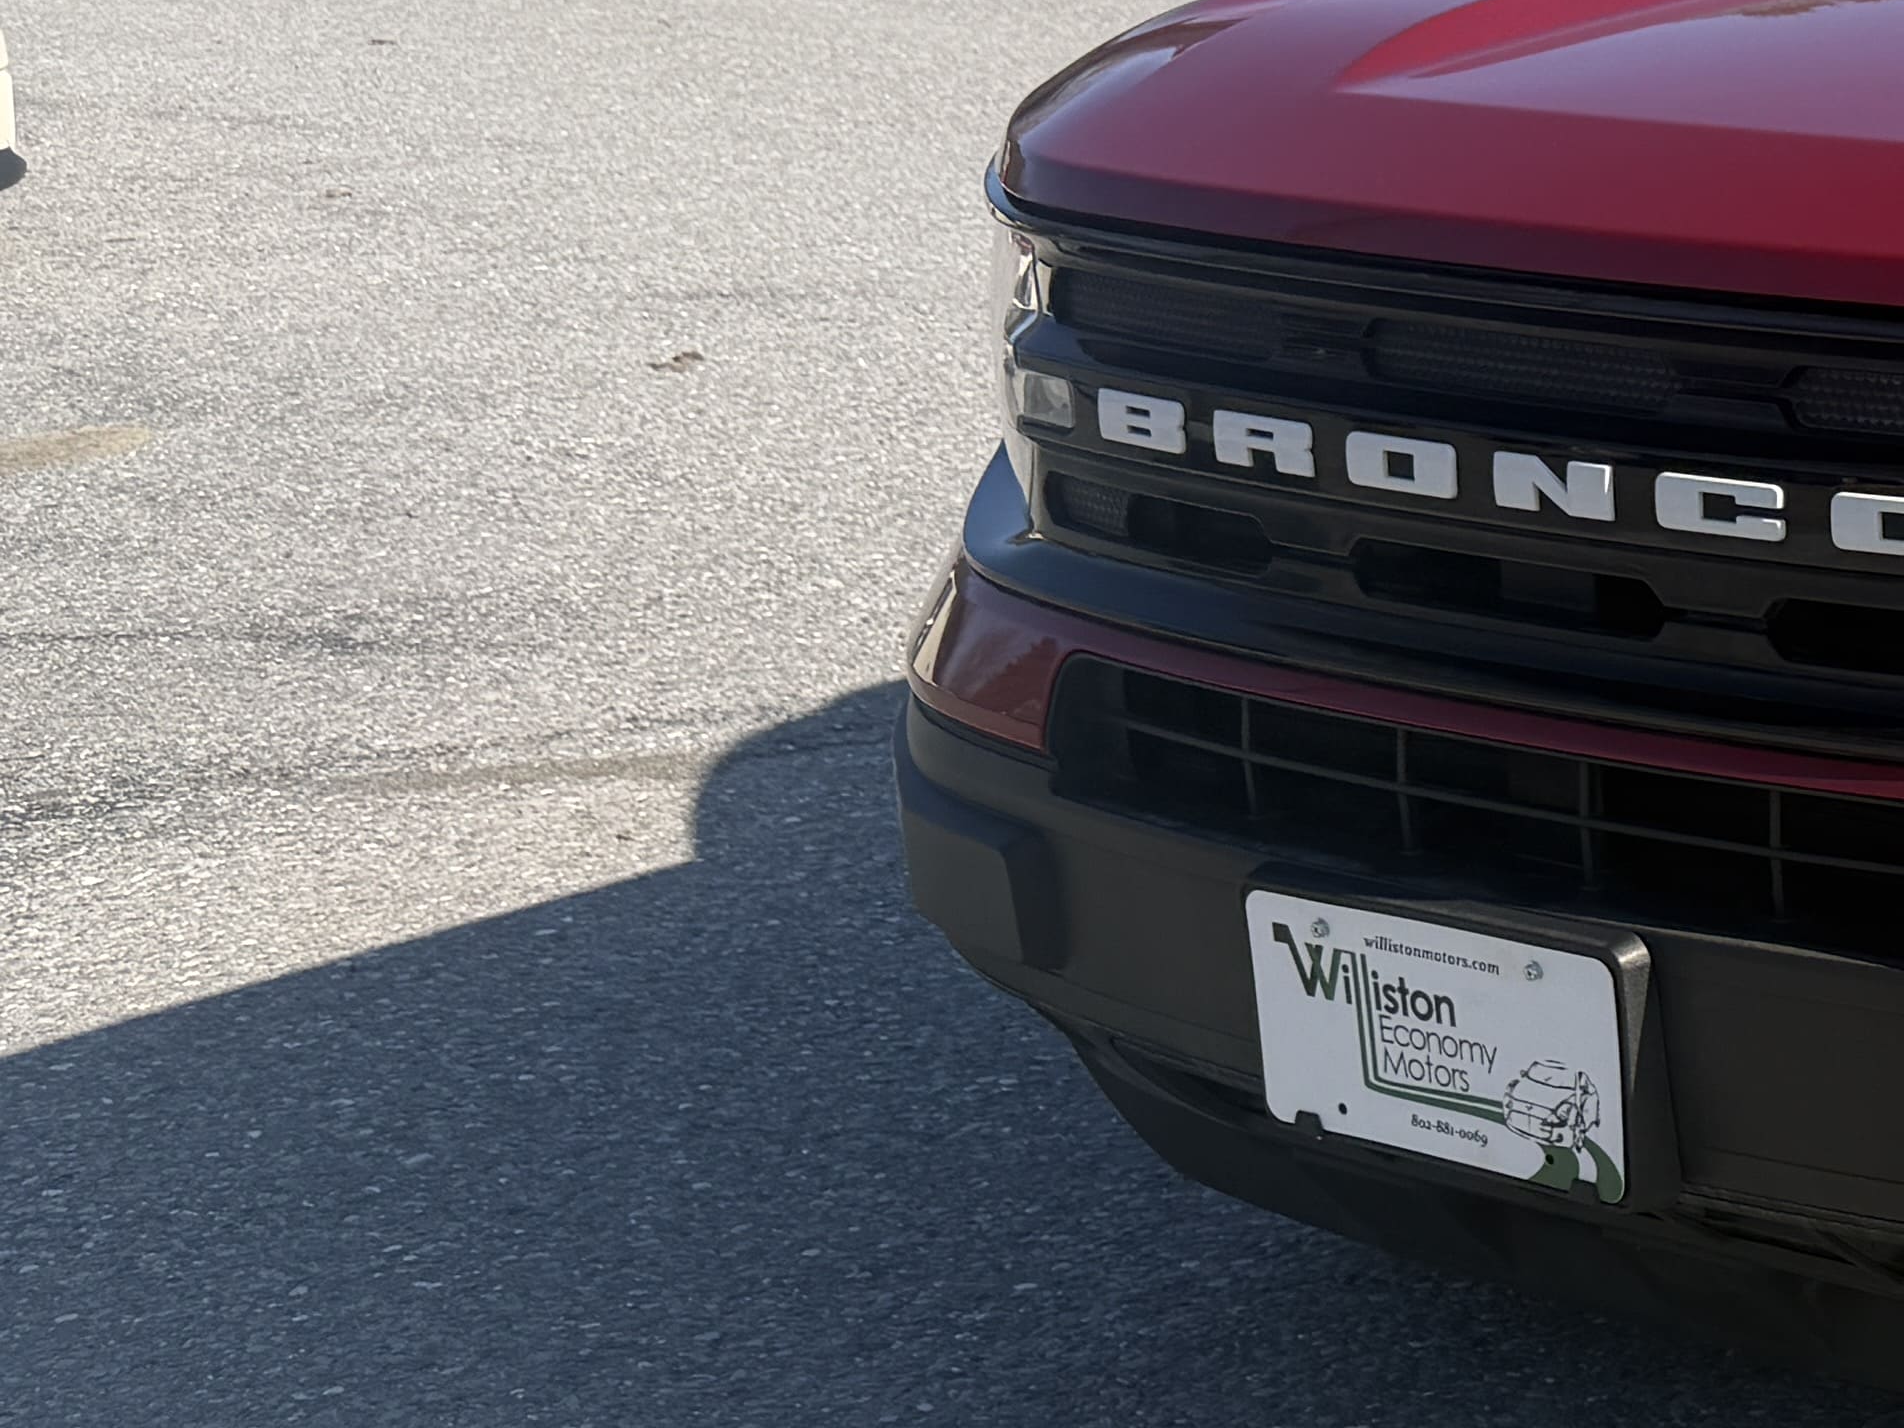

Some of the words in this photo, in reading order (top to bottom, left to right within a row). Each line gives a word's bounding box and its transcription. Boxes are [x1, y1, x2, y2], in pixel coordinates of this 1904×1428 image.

[1272, 921, 1457, 1027] Williston
[1363, 935, 1500, 975] willistonmotors.com
[1379, 1014, 1497, 1074] Economy
[1383, 1047, 1470, 1093] Motors
